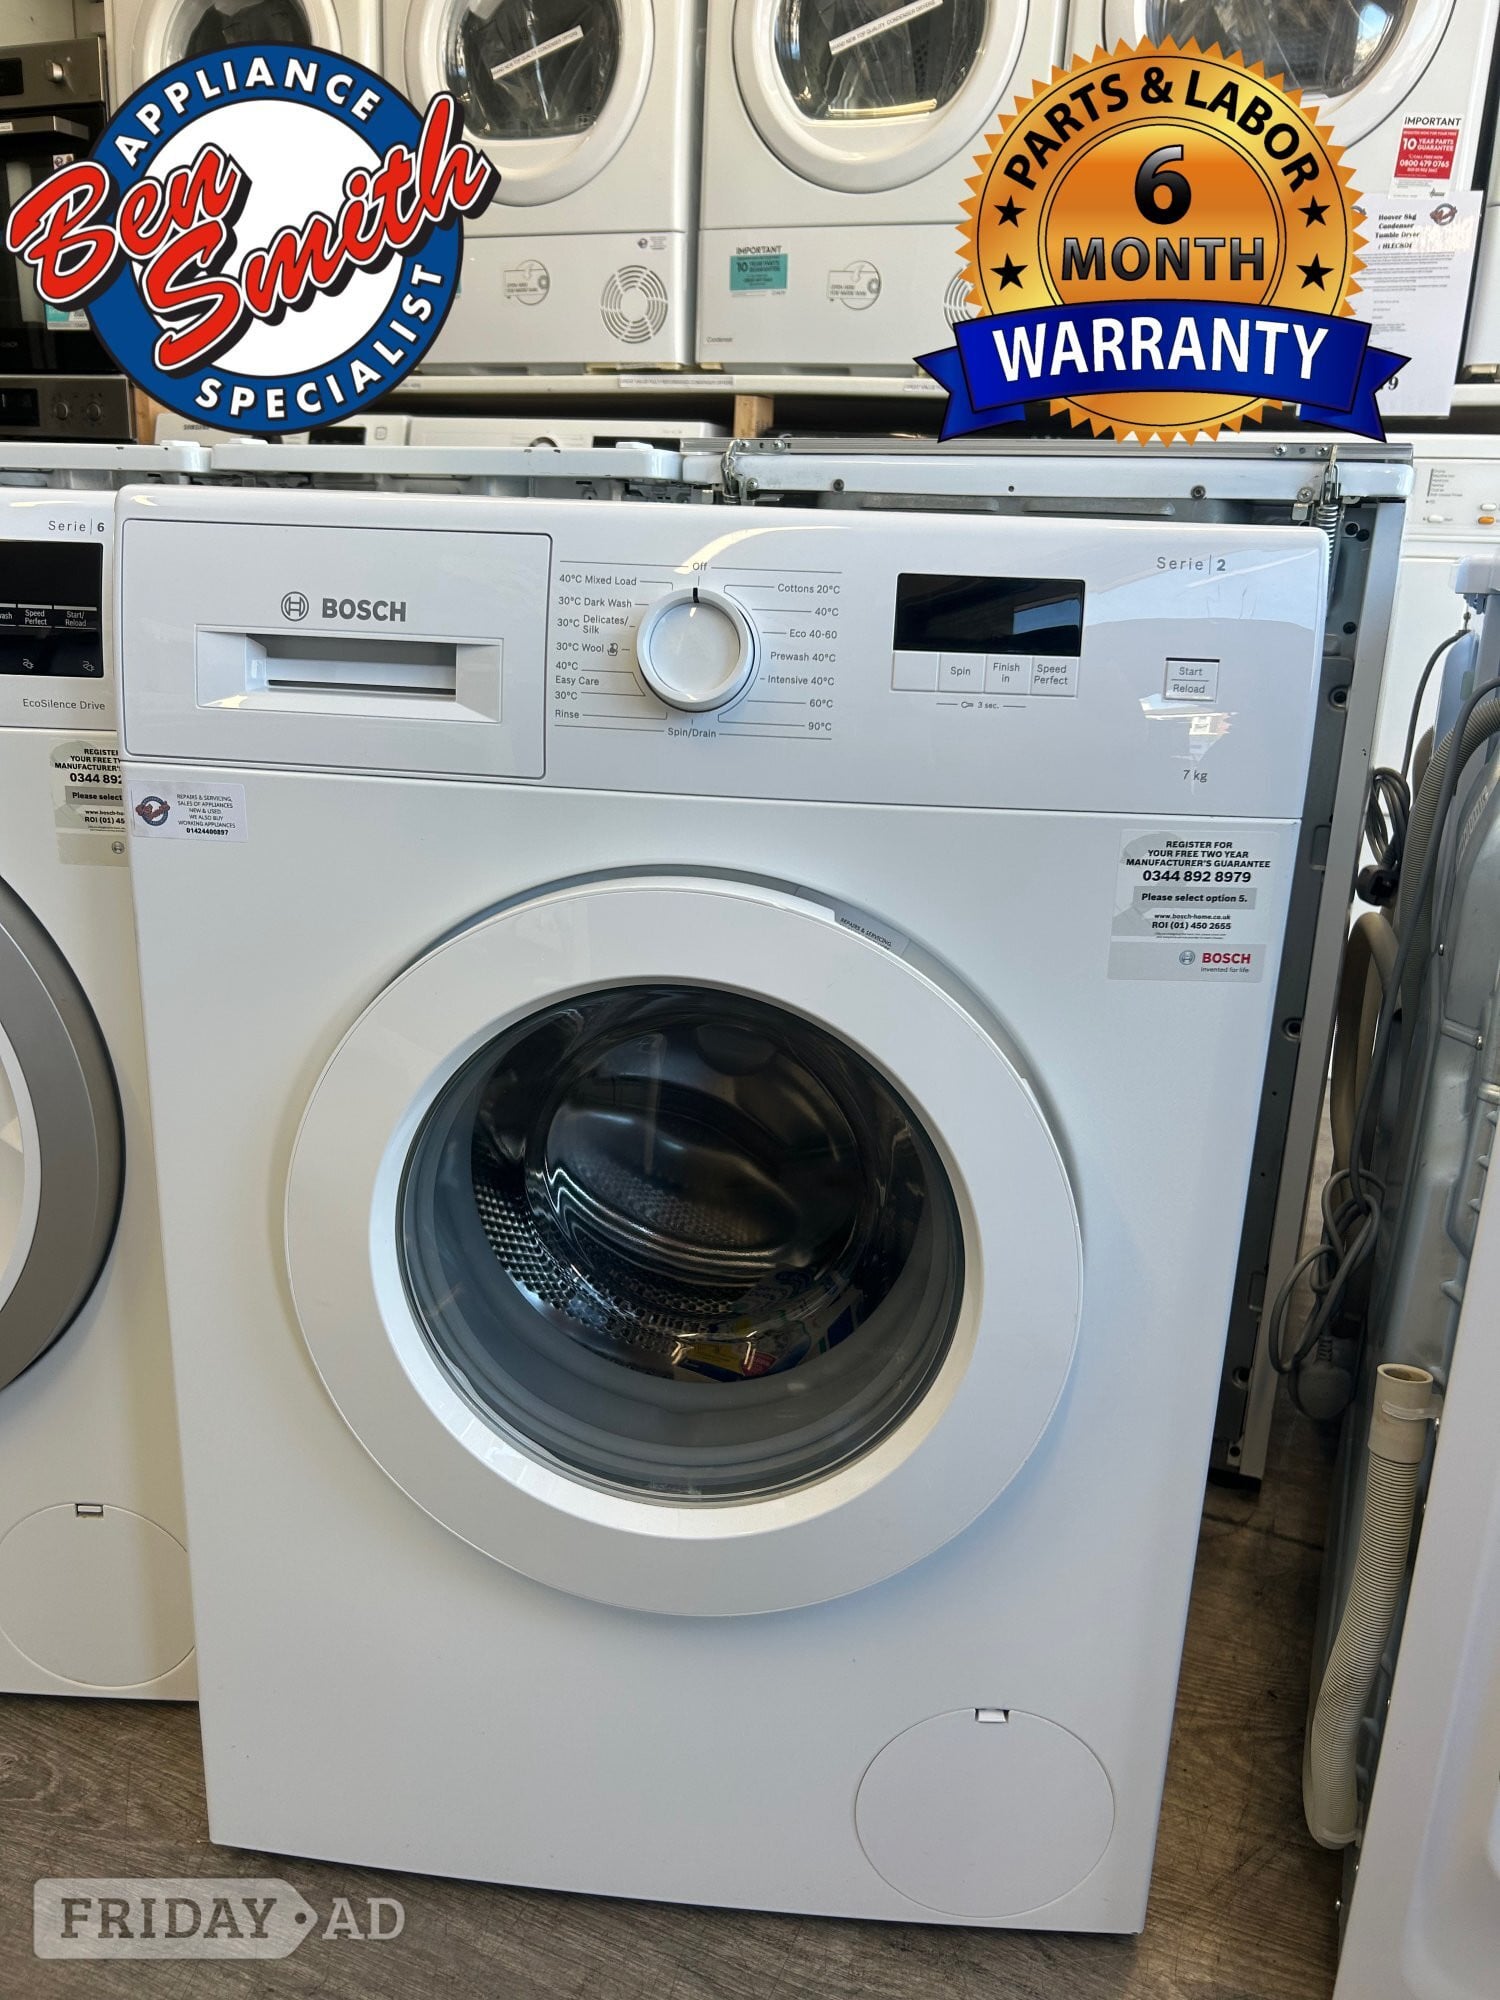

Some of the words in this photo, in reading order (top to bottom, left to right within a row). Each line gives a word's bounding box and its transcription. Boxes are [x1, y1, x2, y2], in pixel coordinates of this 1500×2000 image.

[1404, 117, 1461, 126] IMPORTANT
[1403, 138, 1417, 150] 10
[1404, 213, 1417, 221] 8kg
[736, 246, 782, 254] IMPORTANT
[48, 520, 86, 532] Serie
[97, 522, 105, 532] 6
[692, 561, 708, 571] Off
[1156, 556, 1204, 571] Serie
[1217, 558, 1226, 572] 2
[585, 576, 611, 585] Mixed
[615, 576, 637, 585] Load
[778, 583, 814, 593] Cottons
[584, 597, 605, 607] Dark
[608, 598, 632, 608] Wash
[25, 609, 45, 618] Speed
[66, 610, 85, 619] Start/
[322, 597, 406, 622] BOSCH
[25, 617, 47, 626] Perfect
[65, 619, 87, 627] Reload
[583, 614, 629, 626] Delicates/
[583, 625, 599, 634] Silk
[790, 628, 807, 638] Eco
[581, 643, 604, 652] Wool
[770, 651, 809, 661] Prewash
[950, 666, 971, 677] Spin
[993, 661, 1020, 673] Finish
[1037, 664, 1067, 676] Speed
[1178, 666, 1203, 677] Start
[555, 675, 576, 686] Easy
[578, 676, 600, 686] Care
[768, 675, 808, 685] Intensive
[1001, 673, 1010, 684] in
[1033, 674, 1068, 686] Perfect
[1173, 682, 1205, 694] Reload
[23, 699, 77, 709] EcoSilence
[80, 701, 106, 710] Drive
[985, 702, 1000, 710] sec.
[555, 710, 579, 719] Rinse
[667, 727, 717, 738] Spin/Drain
[70, 773, 100, 783] 0344
[1183, 769, 1190, 780] 7
[1193, 769, 1208, 783] kg
[1166, 841, 1212, 849] REGISTER
[1148, 849, 1173, 857] YOUR
[1175, 850, 1199, 858] FREE
[1126, 858, 1212, 867] MANUFACTURER'S
[1214, 860, 1271, 868] GUARANTEE
[1143, 870, 1180, 882] 0344
[1183, 871, 1211, 882] 892
[1214, 871, 1252, 883] 8979
[1142, 893, 1173, 901] Please
[1175, 894, 1204, 902] select
[1206, 895, 1236, 904] option
[1239, 895, 1248, 903] 5.
[1170, 922, 1189, 930] (01)
[841, 917, 861, 931] REPAIRS
[865, 930, 892, 947] SERVICING
[1202, 952, 1251, 964] BOSCH
